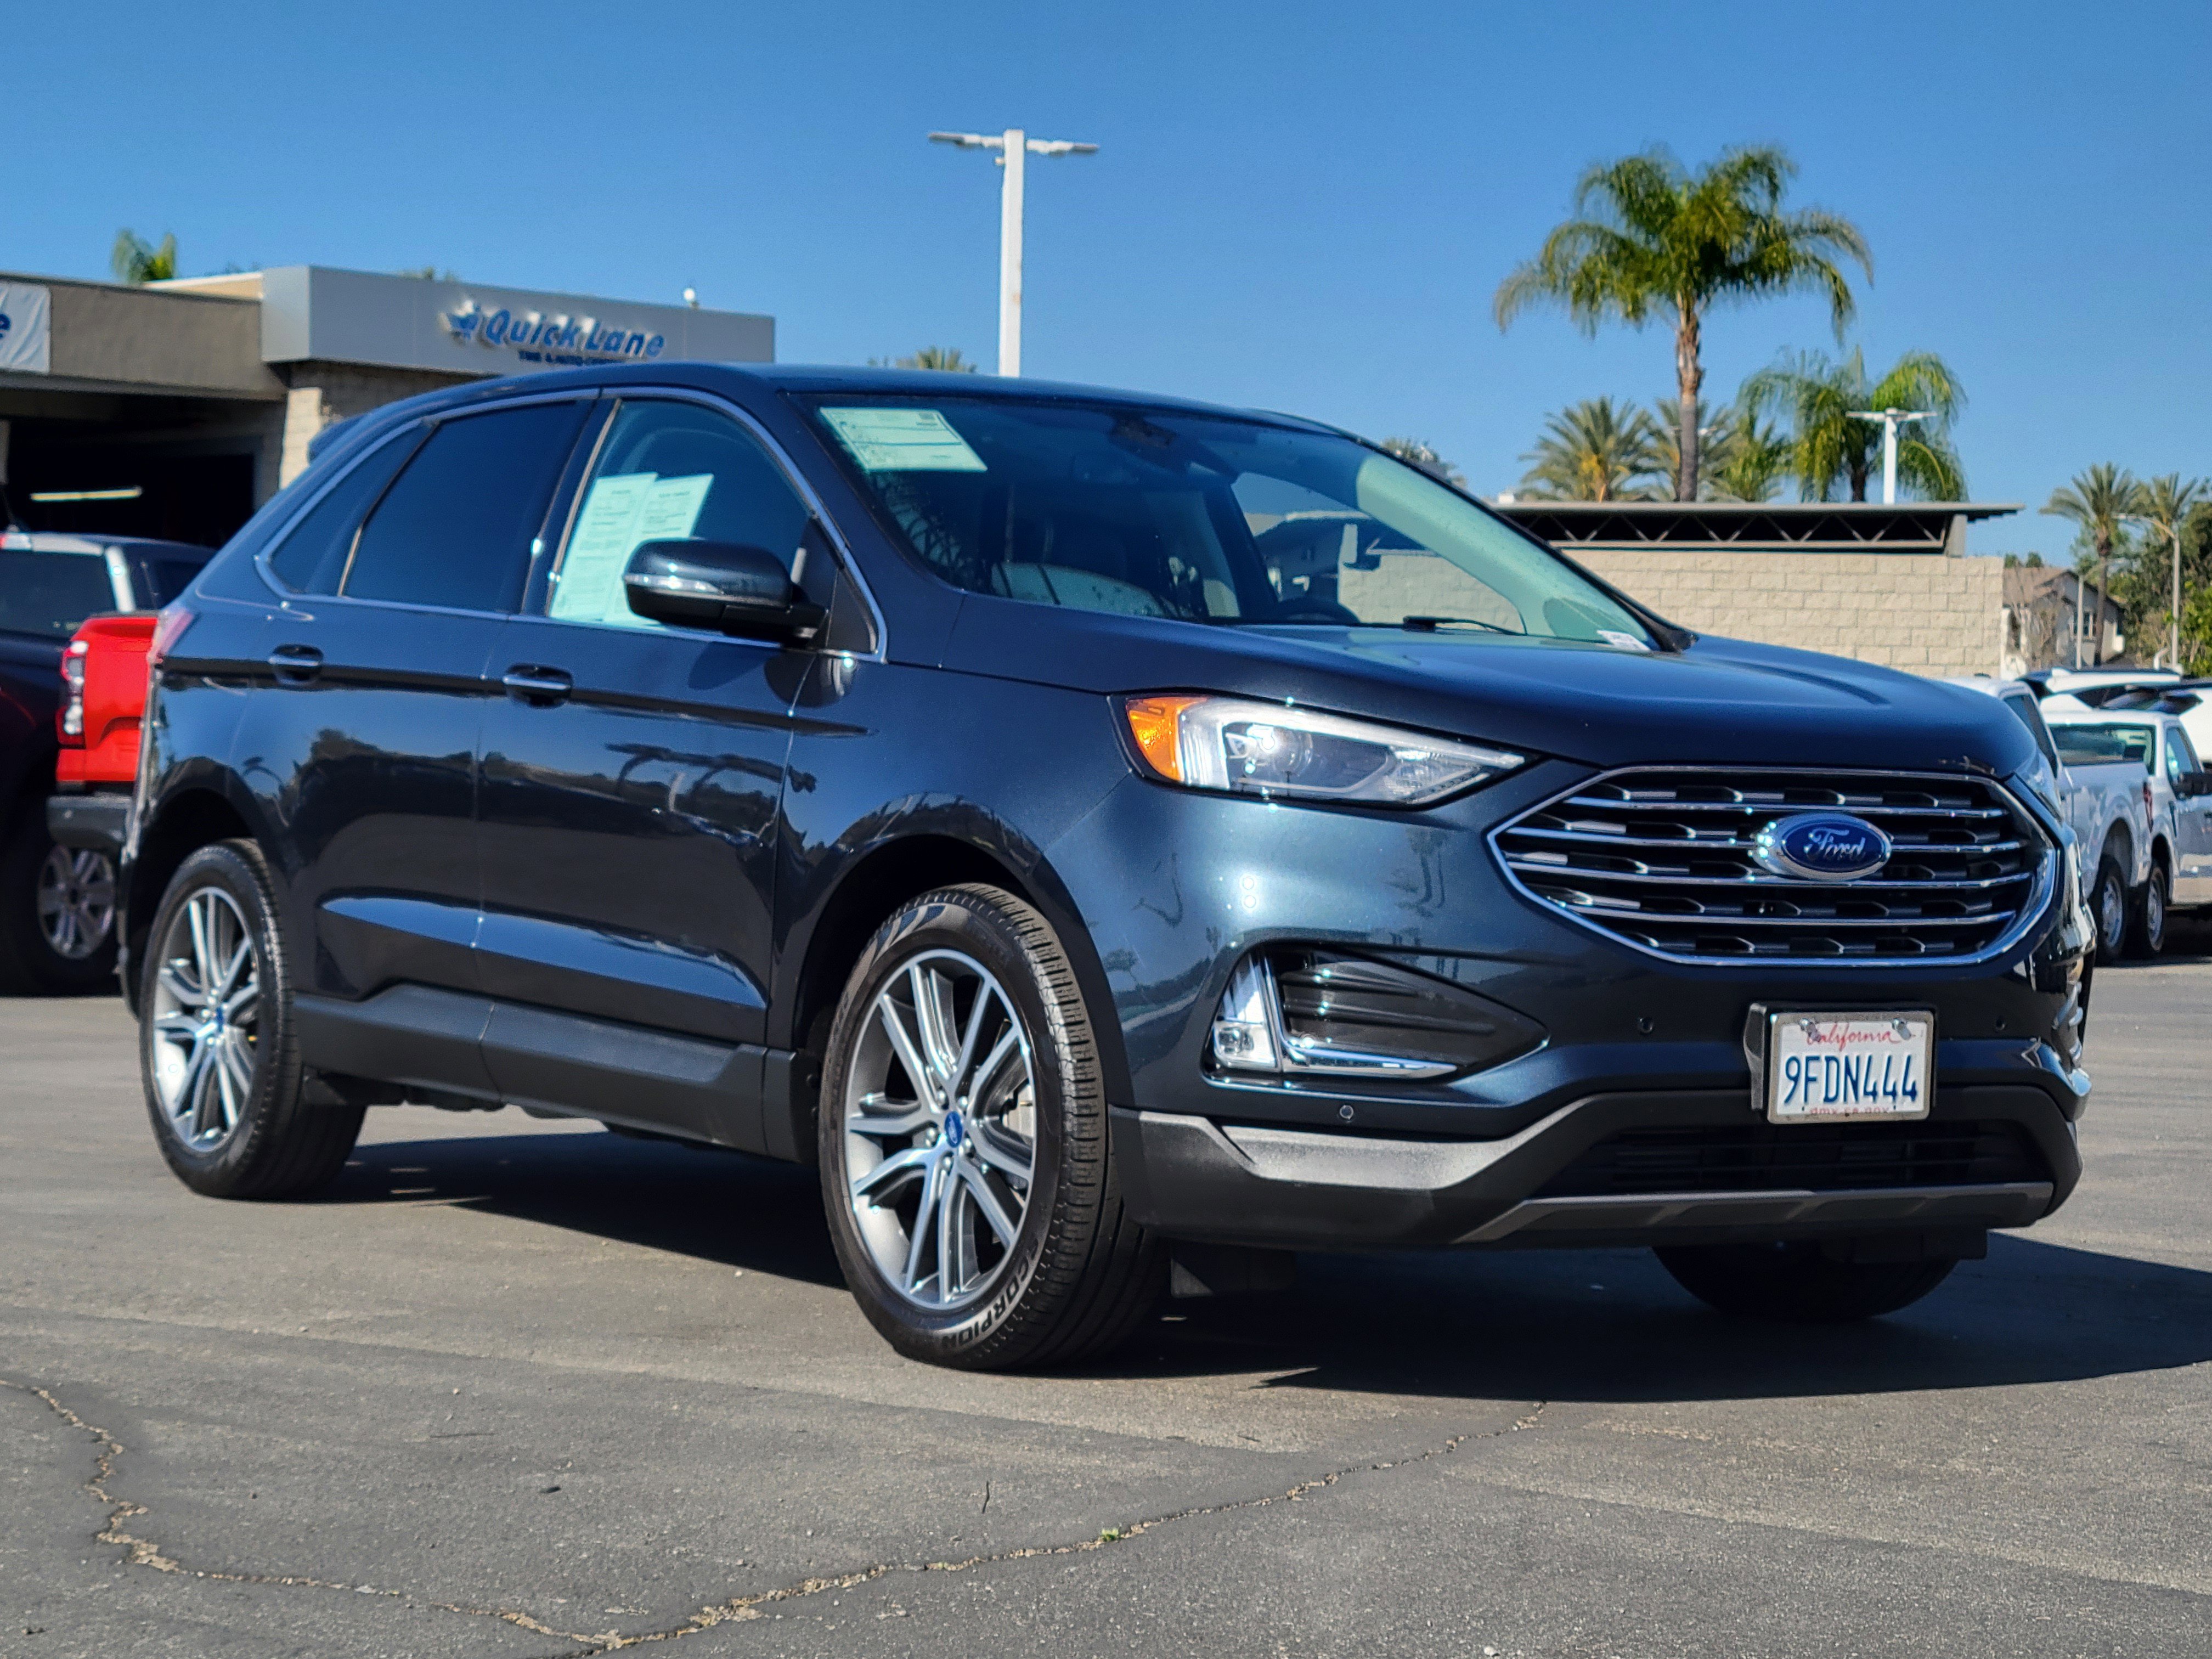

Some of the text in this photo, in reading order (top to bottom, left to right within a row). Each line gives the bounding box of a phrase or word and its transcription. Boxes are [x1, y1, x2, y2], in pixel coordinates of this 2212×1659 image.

[486, 308, 664, 357] Quick Lane
[1803, 826, 1866, 861] Ford
[1783, 1054, 1918, 1105] 9FDN444
[1810, 1106, 1890, 1114] dmvcagov
[940, 1237, 1040, 1347] SCORPION
